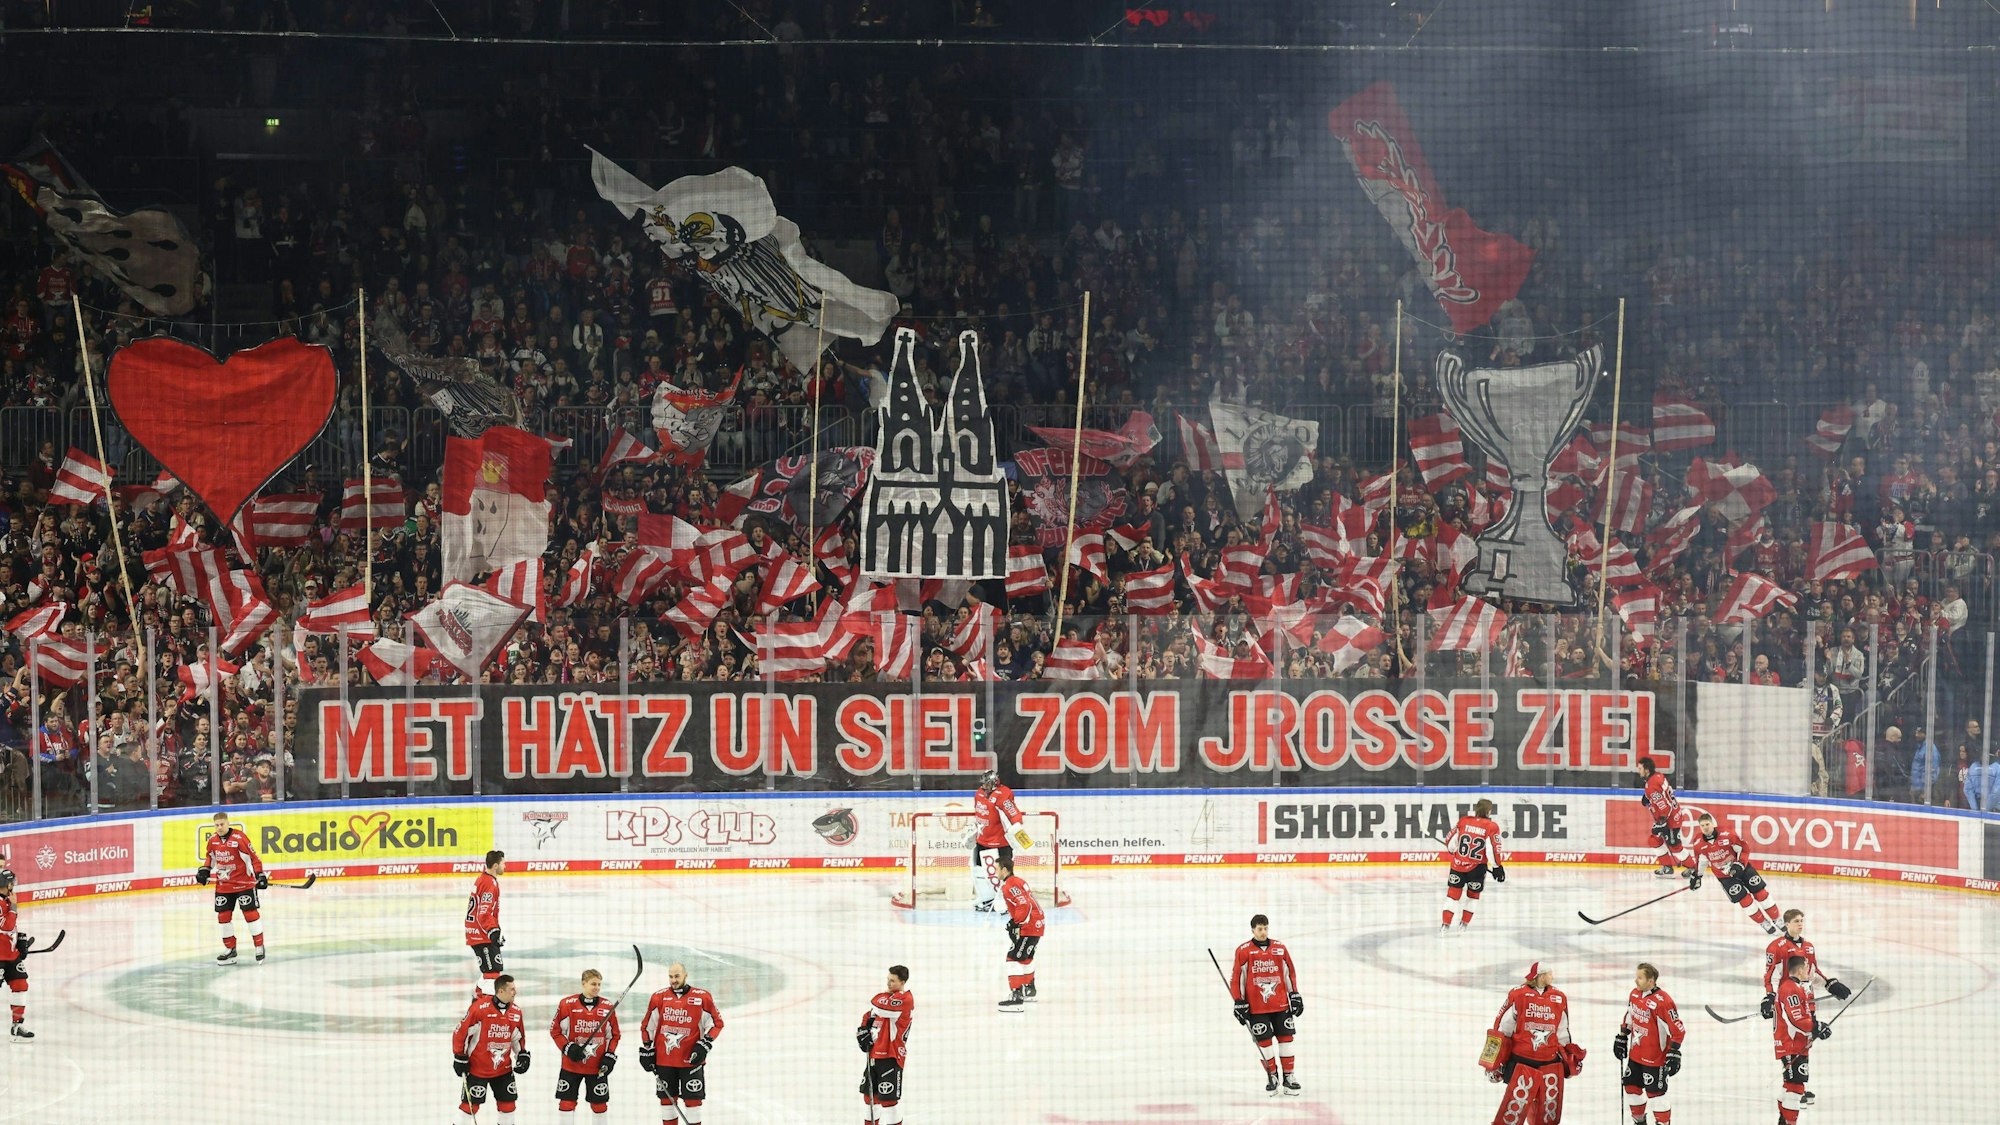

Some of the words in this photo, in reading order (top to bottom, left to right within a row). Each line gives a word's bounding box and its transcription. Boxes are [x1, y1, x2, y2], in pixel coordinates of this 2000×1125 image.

[318, 697, 484, 784] MET
[501, 691, 694, 780] HÄTZ
[709, 691, 819, 777] UN
[834, 692, 998, 776] SIEL
[1015, 690, 1181, 775] ZOM
[1198, 689, 1499, 773] JROSSE
[1516, 688, 1676, 775] ZIEL
[1274, 803, 1568, 840] SHOP.HA.DE
[688, 810, 777, 846] CLUB
[1727, 813, 1882, 853] TOYOTA
[261, 820, 359, 855] Radio
[378, 816, 458, 850] Köln
[1058, 837, 1119, 848] Menschen
[1123, 837, 1166, 848] helfen.
[1458, 833, 1486, 861] 62
[100, 846, 129, 861] Köln
[1111, 854, 1153, 864] PENNY.
[1184, 854, 1225, 864] PENNY.
[1256, 853, 1297, 863] PENNY.
[1328, 852, 1369, 862] PENNY.
[1400, 852, 1441, 862] PENNY.
[1545, 852, 1586, 863] PENNY.
[527, 861, 570, 871] PENNY.
[601, 860, 643, 870] PENNY.
[675, 859, 717, 869] PENNY.
[749, 858, 791, 868] PENNY.
[823, 857, 864, 867] PENNY.
[1763, 861, 1803, 873] PENNY.
[378, 864, 420, 875] PENNY.
[1833, 866, 1872, 878] PENNY.
[1901, 871, 1938, 884] PENNY.
[95, 881, 132, 893] PENNY.
[32, 887, 67, 900] PENNY.
[1787, 994, 1800, 1007] 10
[664, 1006, 688, 1017] Rhein
[1528, 1002, 1551, 1012] Rhein
[1525, 1009, 1556, 1021] Energie
